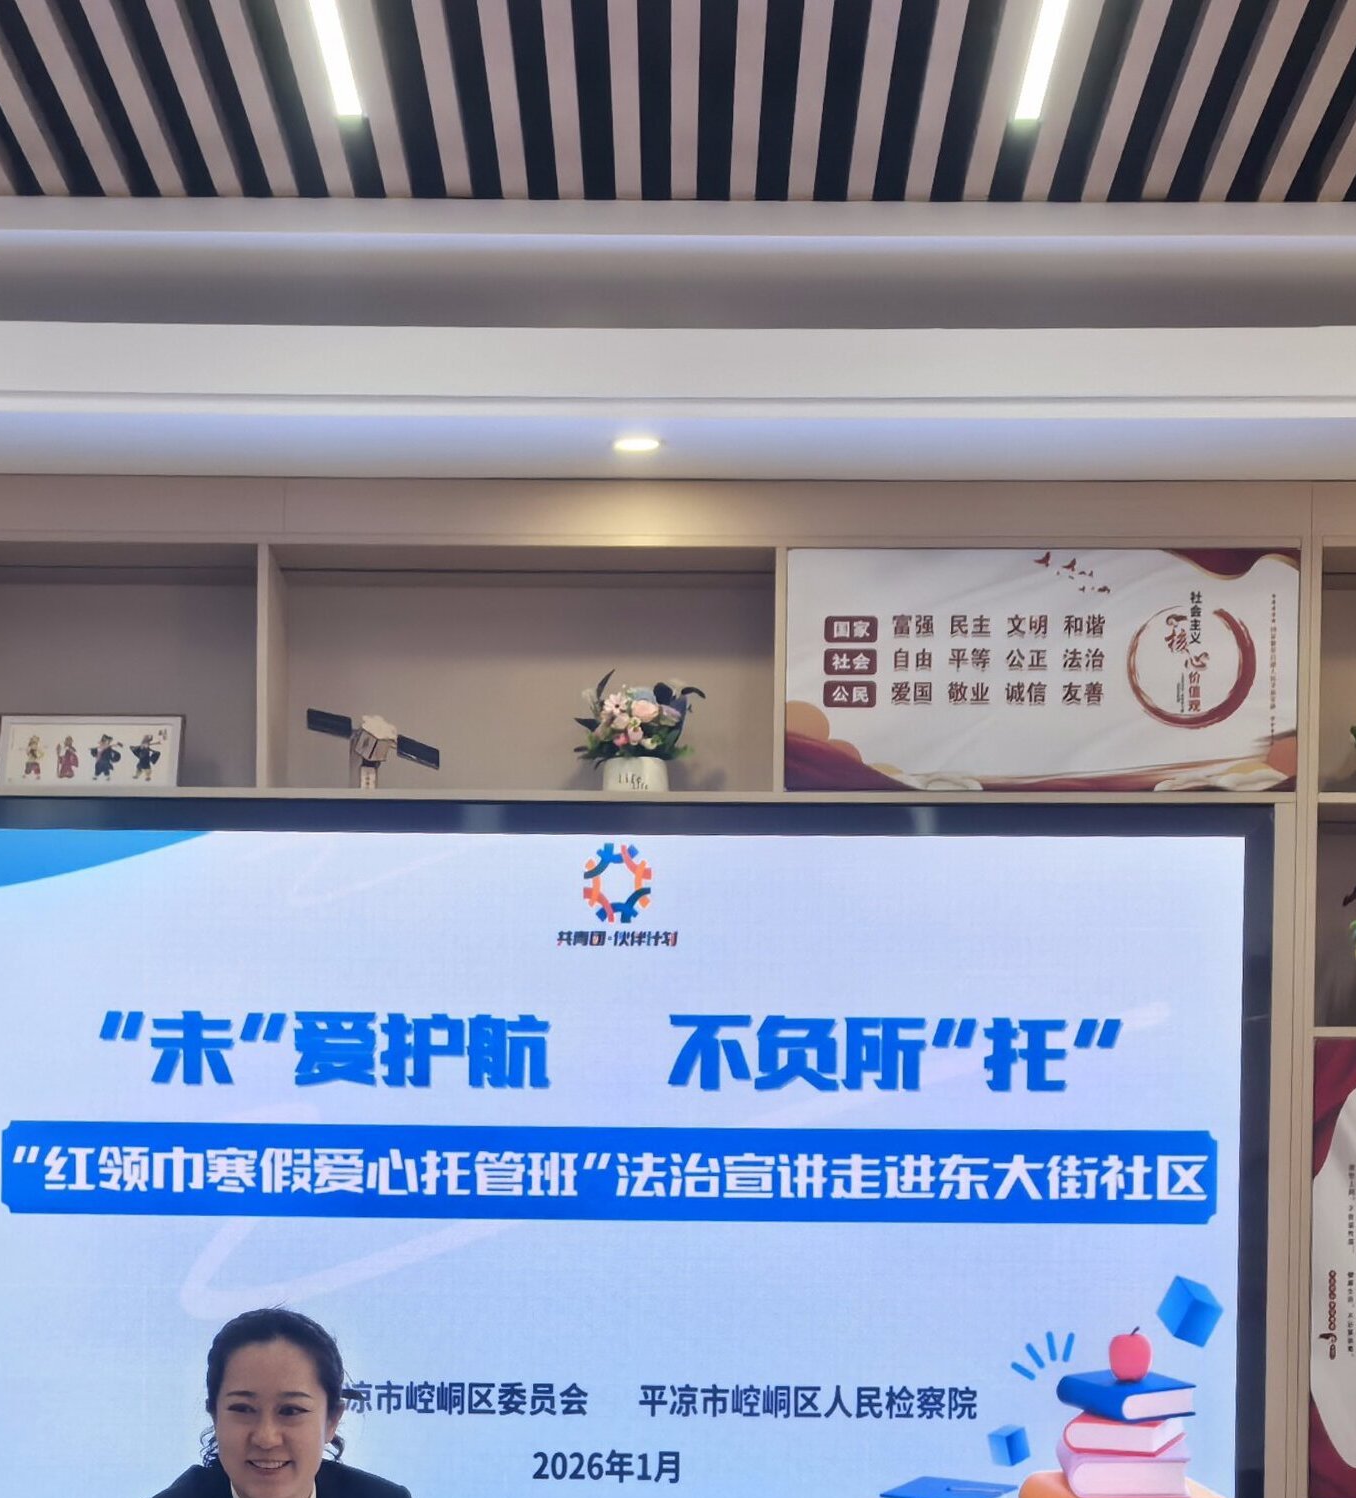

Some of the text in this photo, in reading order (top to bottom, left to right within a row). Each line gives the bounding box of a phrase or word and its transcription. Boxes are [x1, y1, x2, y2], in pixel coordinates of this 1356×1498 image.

[832, 613, 1106, 640] 国家 富强 民主 文明 和谐
[1189, 591, 1202, 645] 社会主义
[831, 647, 1105, 672] 社会 自由 平等 公正 法治
[831, 681, 1104, 704] 公民 爱国 敬业 诚信 友善
[638, 1384, 978, 1422] 平凉市崆峒区人民检察院
[532, 1448, 682, 1485] 2026年1月
